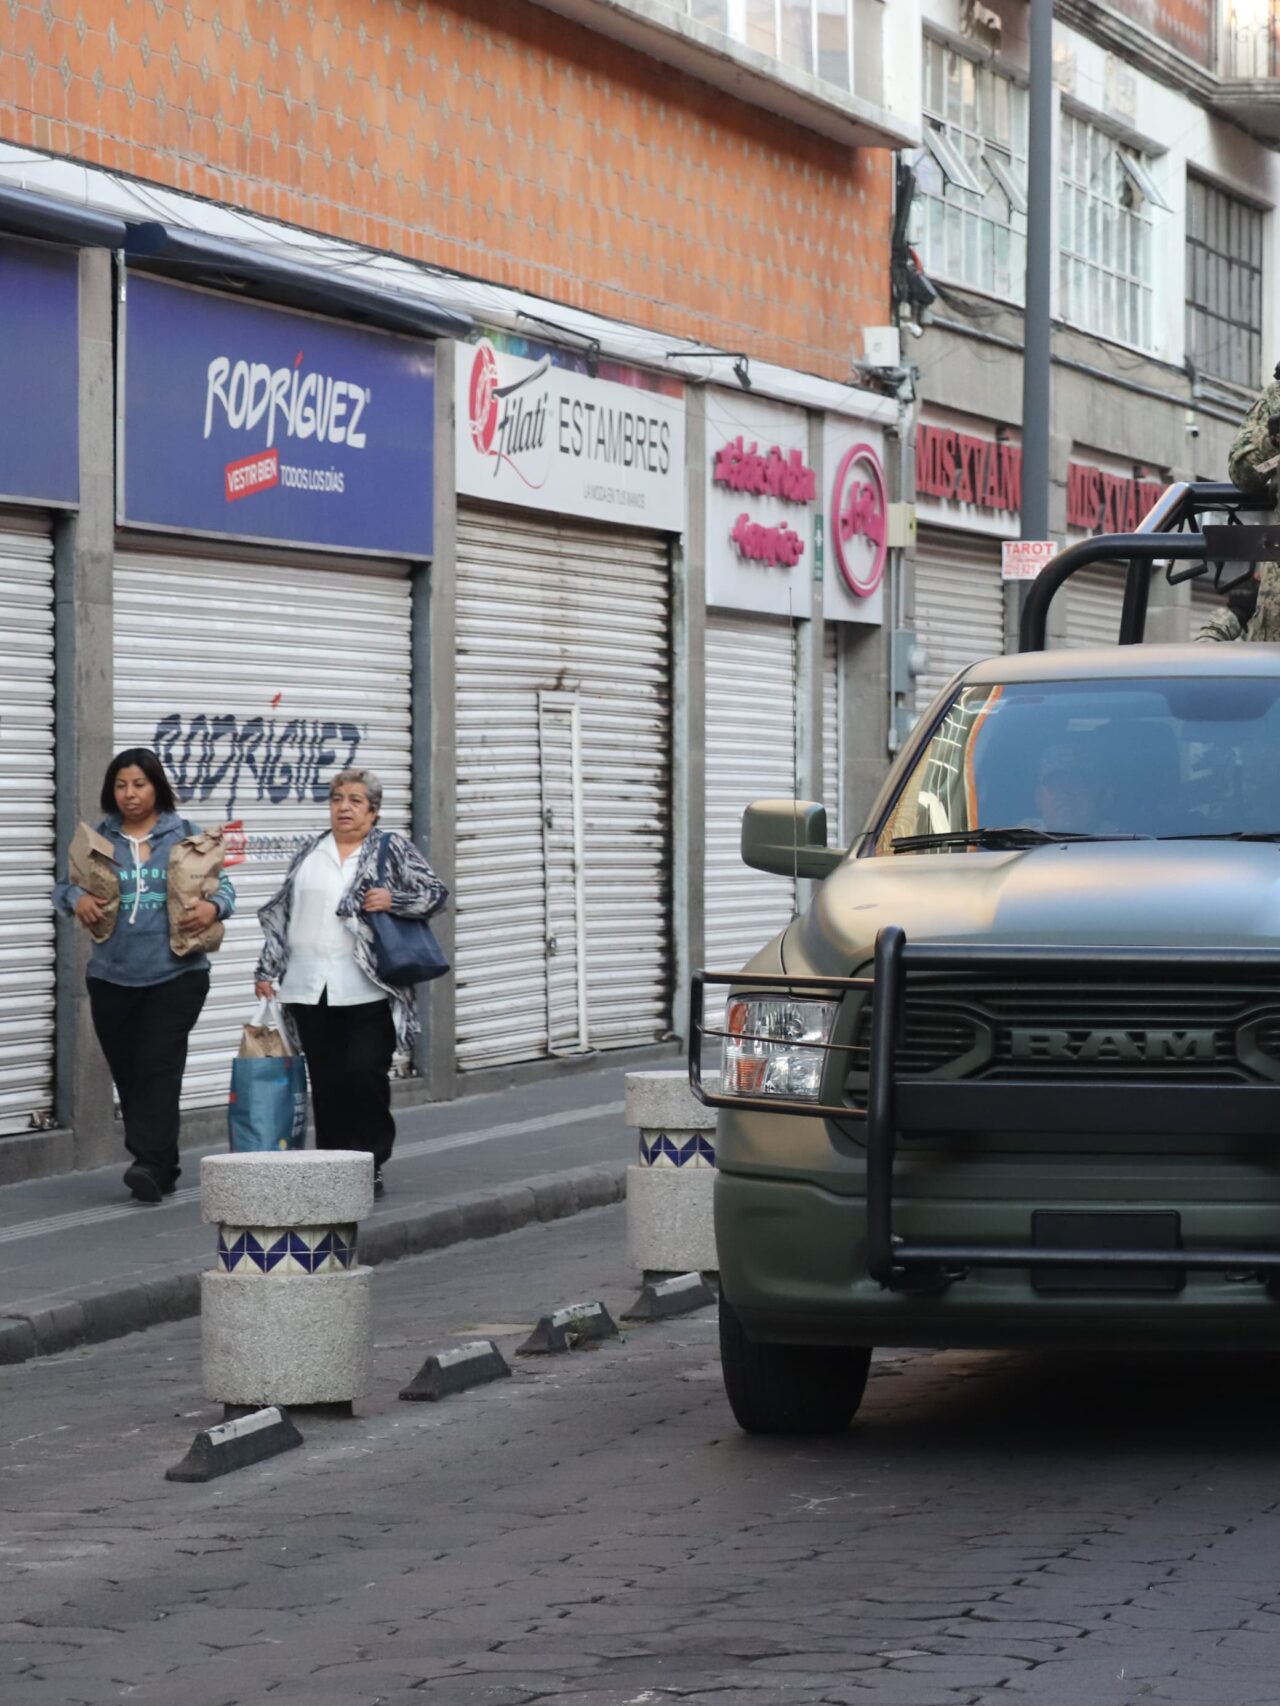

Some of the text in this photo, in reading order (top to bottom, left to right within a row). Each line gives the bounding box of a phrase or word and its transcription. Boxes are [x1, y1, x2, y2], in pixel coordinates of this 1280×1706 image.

[204, 351, 366, 448] RODRÍGUEZ
[558, 396, 670, 475] ESTAMBRES
[227, 457, 345, 493] VESTIR BIEN TODOS LOS DÍAS
[915, 423, 1022, 511] MIS XV AÑ
[1067, 462, 1100, 529] MIS
[1102, 473, 1127, 533] XV
[1004, 543, 1054, 555] TAROT
[119, 868, 167, 880] NAPOL
[1011, 1028, 1216, 1059] RAM
